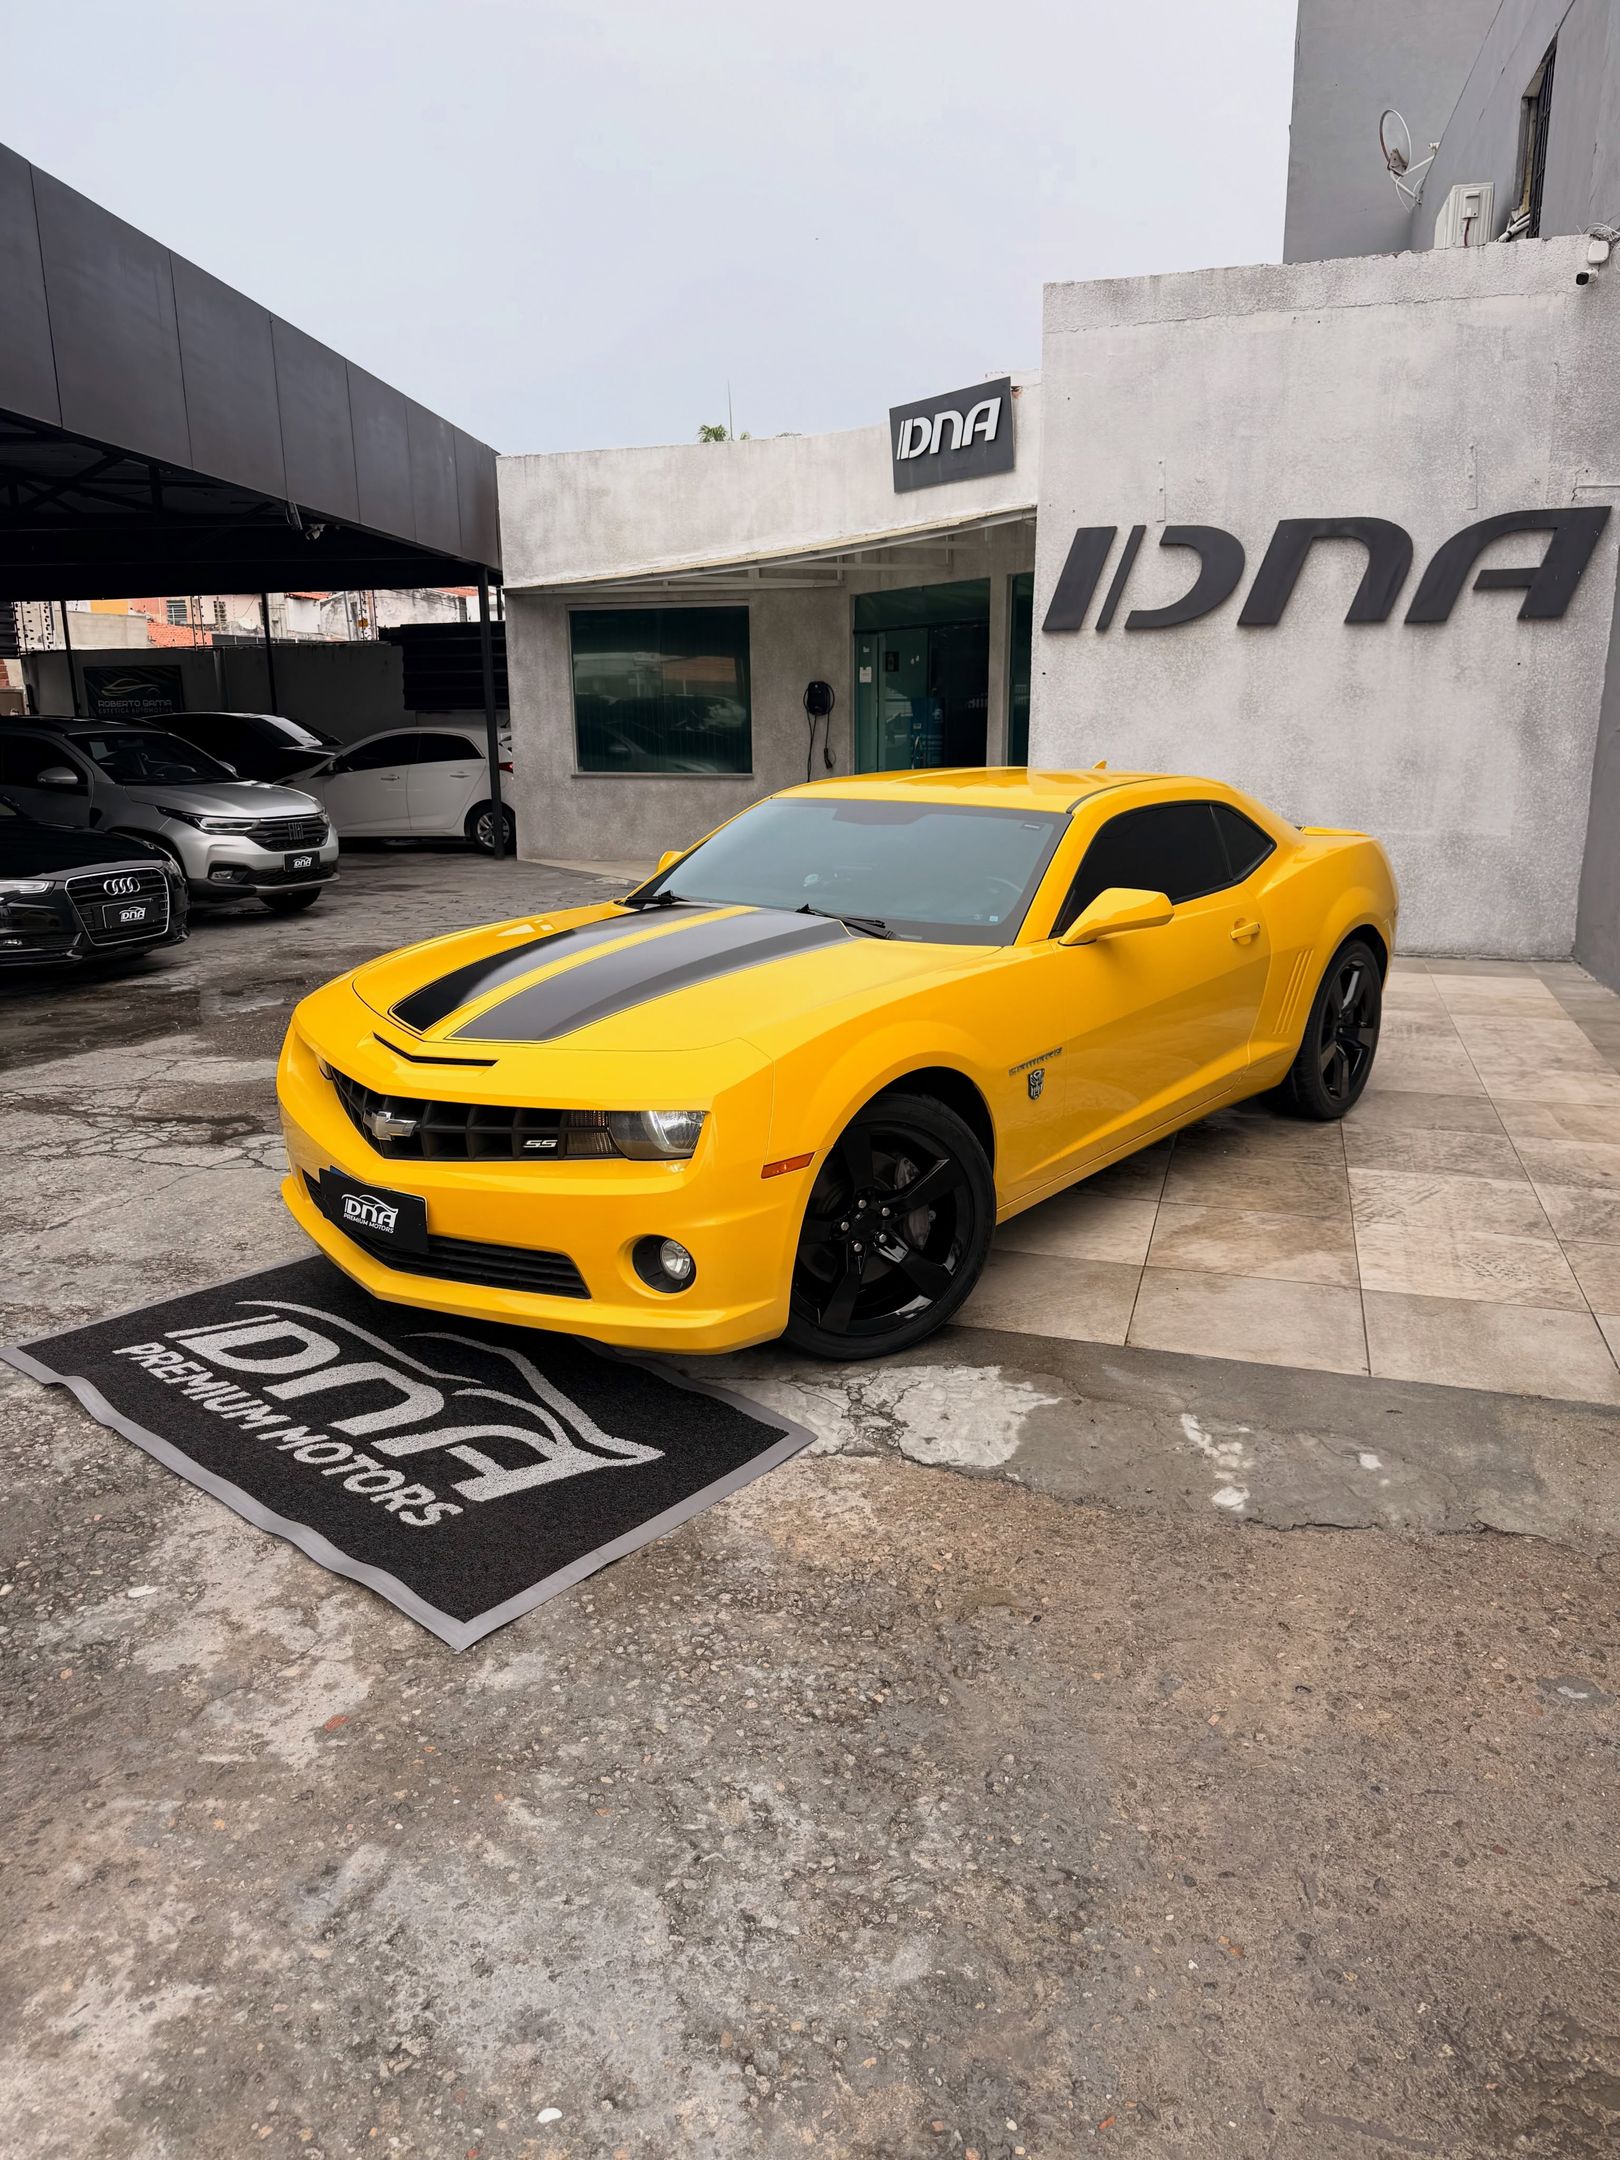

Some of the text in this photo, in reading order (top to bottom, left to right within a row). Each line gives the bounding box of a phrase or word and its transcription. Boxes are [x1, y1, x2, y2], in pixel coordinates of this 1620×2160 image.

[896, 397, 1002, 461] DNA
[1042, 506, 1613, 632] DNA
[97, 699, 172, 708] ROBERTO GAMA
[120, 908, 146, 920] DNA
[523, 1139, 558, 1148] SS
[343, 1213, 394, 1234] PREMIUM MOTORS
[344, 1198, 397, 1228] DNA
[164, 1315, 640, 1502] DNA
[112, 1342, 464, 1527] PREMIUM MOTORS
